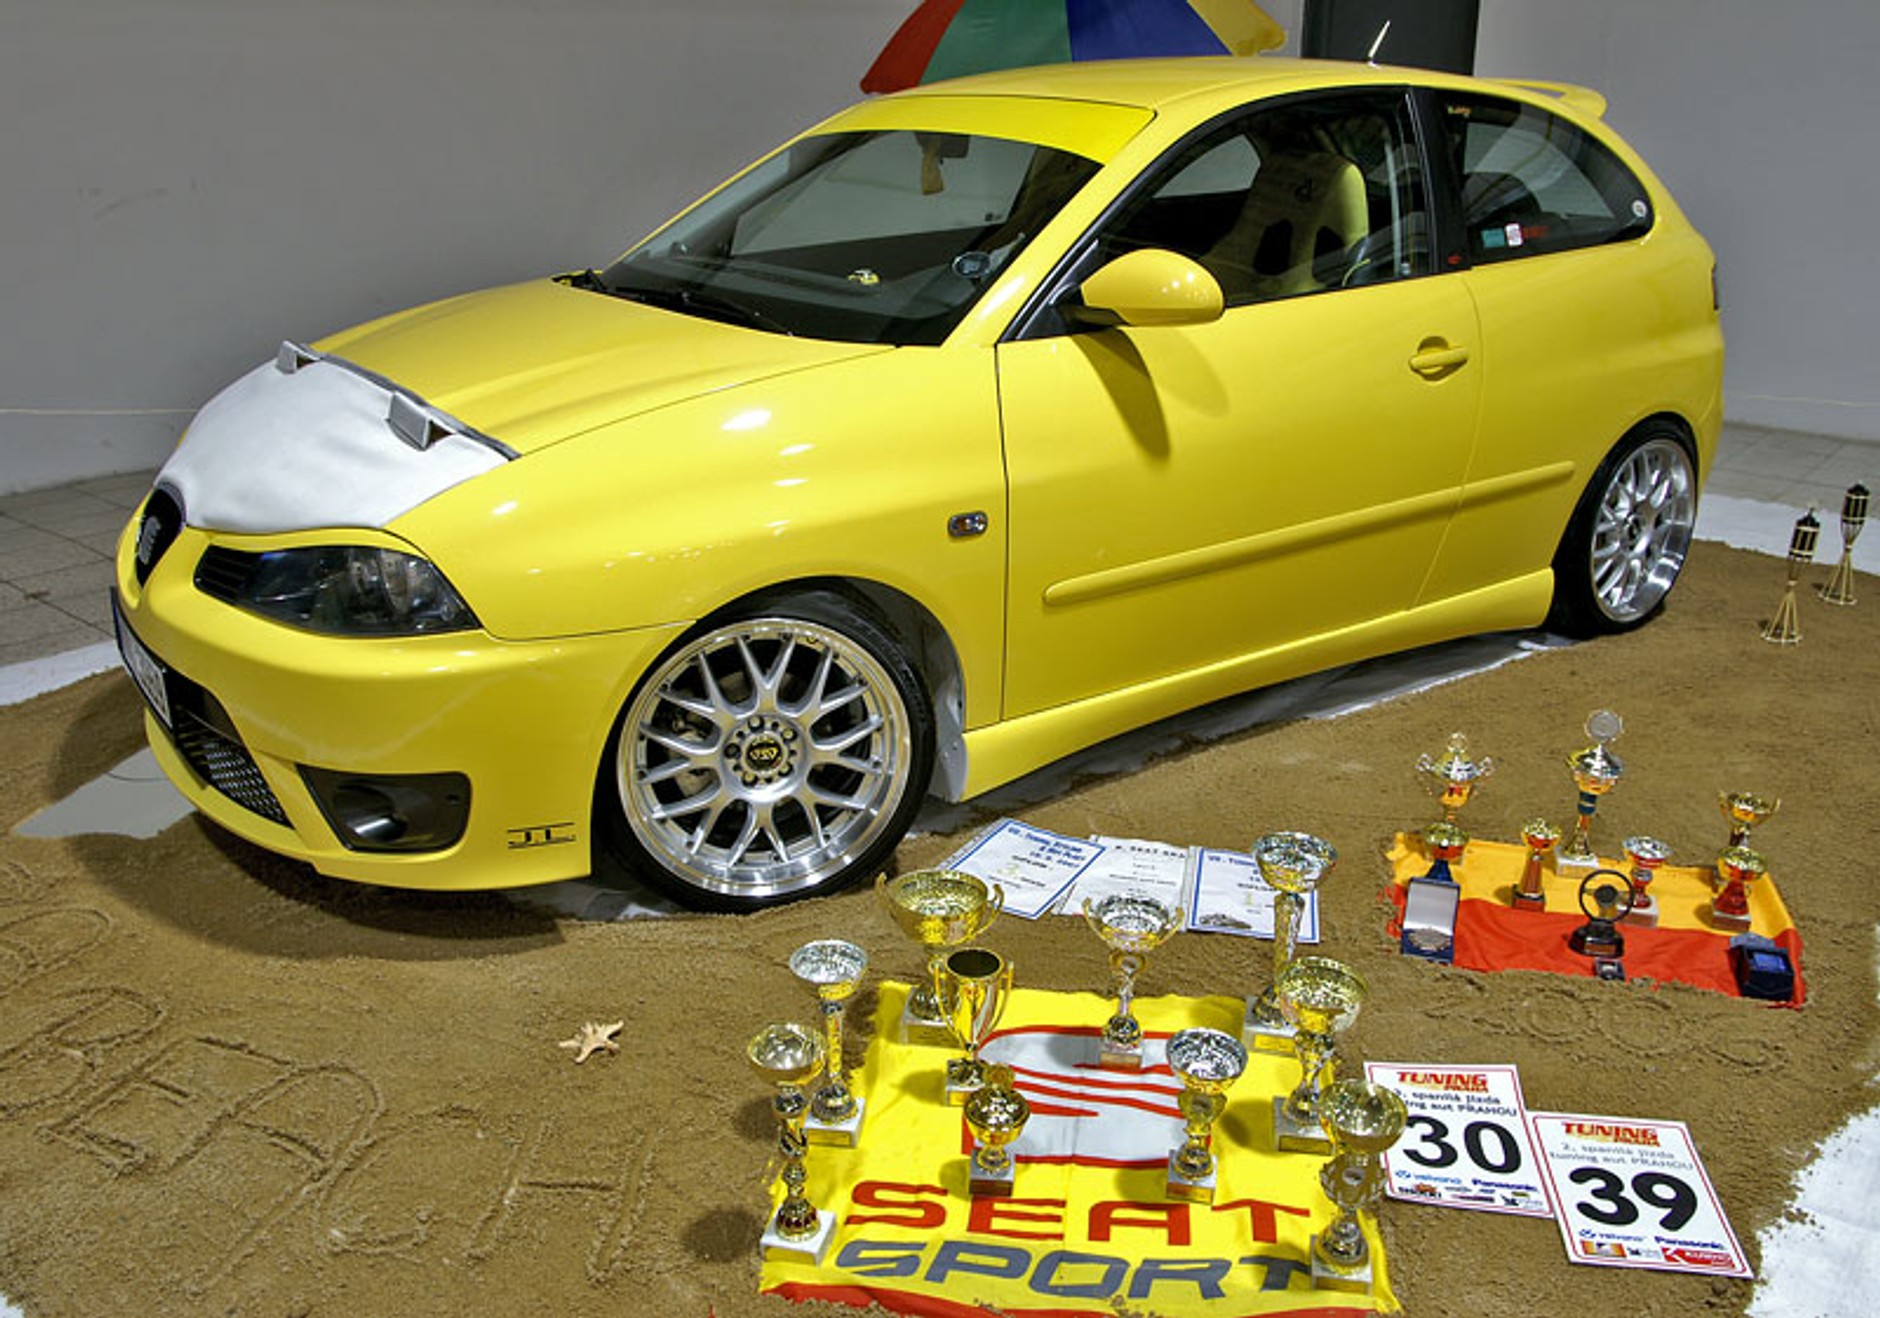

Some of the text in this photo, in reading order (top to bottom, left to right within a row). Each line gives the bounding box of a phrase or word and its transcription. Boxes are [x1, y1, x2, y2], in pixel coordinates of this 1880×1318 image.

[1396, 1071, 1489, 1087] TUNING
[1403, 1114, 1522, 1174] 30
[1562, 1121, 1658, 1140] TUNING
[845, 1181, 1311, 1246] SEAT
[1568, 1166, 1698, 1231] 39
[836, 1239, 1312, 1299] SPORT
